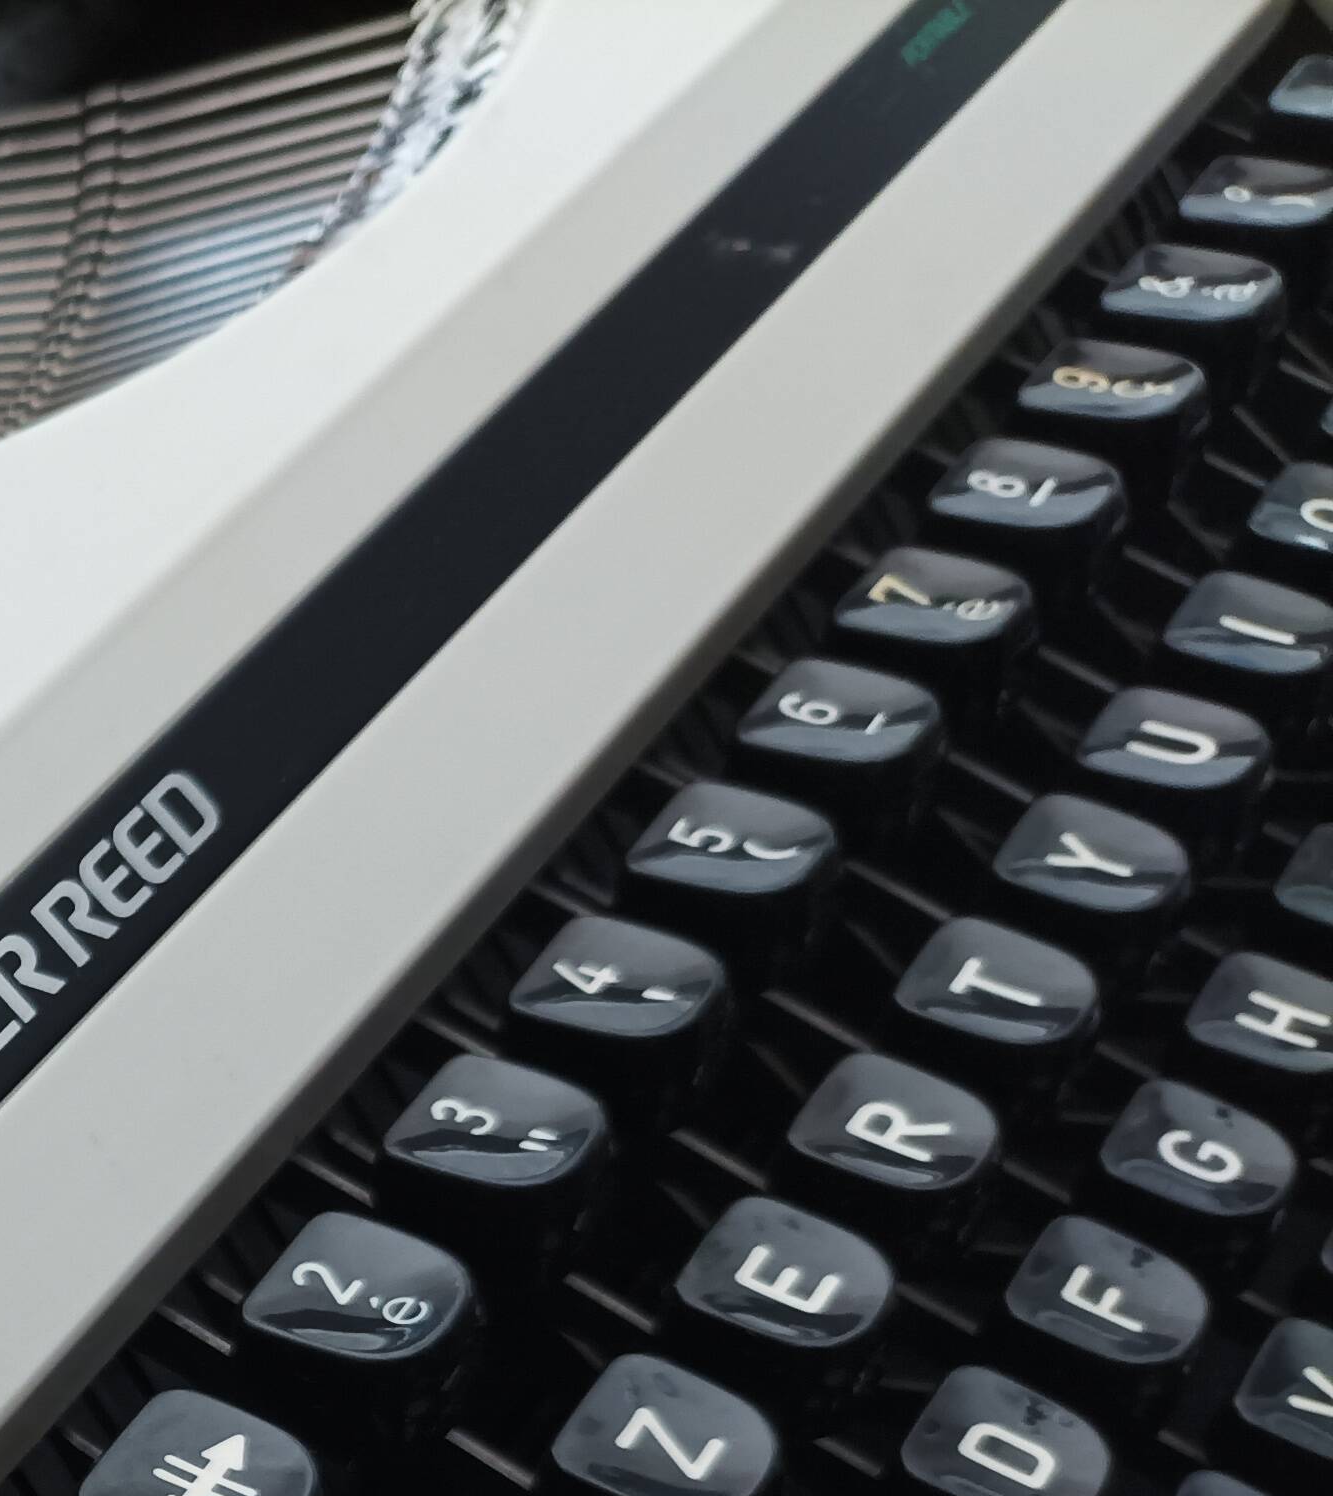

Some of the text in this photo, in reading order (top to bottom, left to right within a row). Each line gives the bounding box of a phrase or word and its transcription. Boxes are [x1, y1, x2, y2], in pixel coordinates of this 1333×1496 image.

[1052, 368, 1111, 395] 9
[967, 470, 1027, 499] 8
[868, 573, 931, 607] 7
[1218, 615, 1296, 646] I
[777, 692, 840, 726] 6
[1126, 719, 1218, 766] U
[666, 817, 736, 854] 5
[1045, 831, 1133, 878] Y
[30, 771, 222, 968] REED
[552, 961, 620, 995] 4
[948, 956, 1043, 1008] T
[1234, 990, 1332, 1049] H
[429, 1097, 499, 1137] 3
[844, 1101, 953, 1163] R
[1157, 1129, 1244, 1184] G
[291, 1260, 365, 1306] 2
[733, 1244, 843, 1315] E
[1060, 1264, 1145, 1333] F
[368, 1295, 430, 1326] é
[614, 1406, 727, 1481] Z
[957, 1421, 1058, 1490] D
